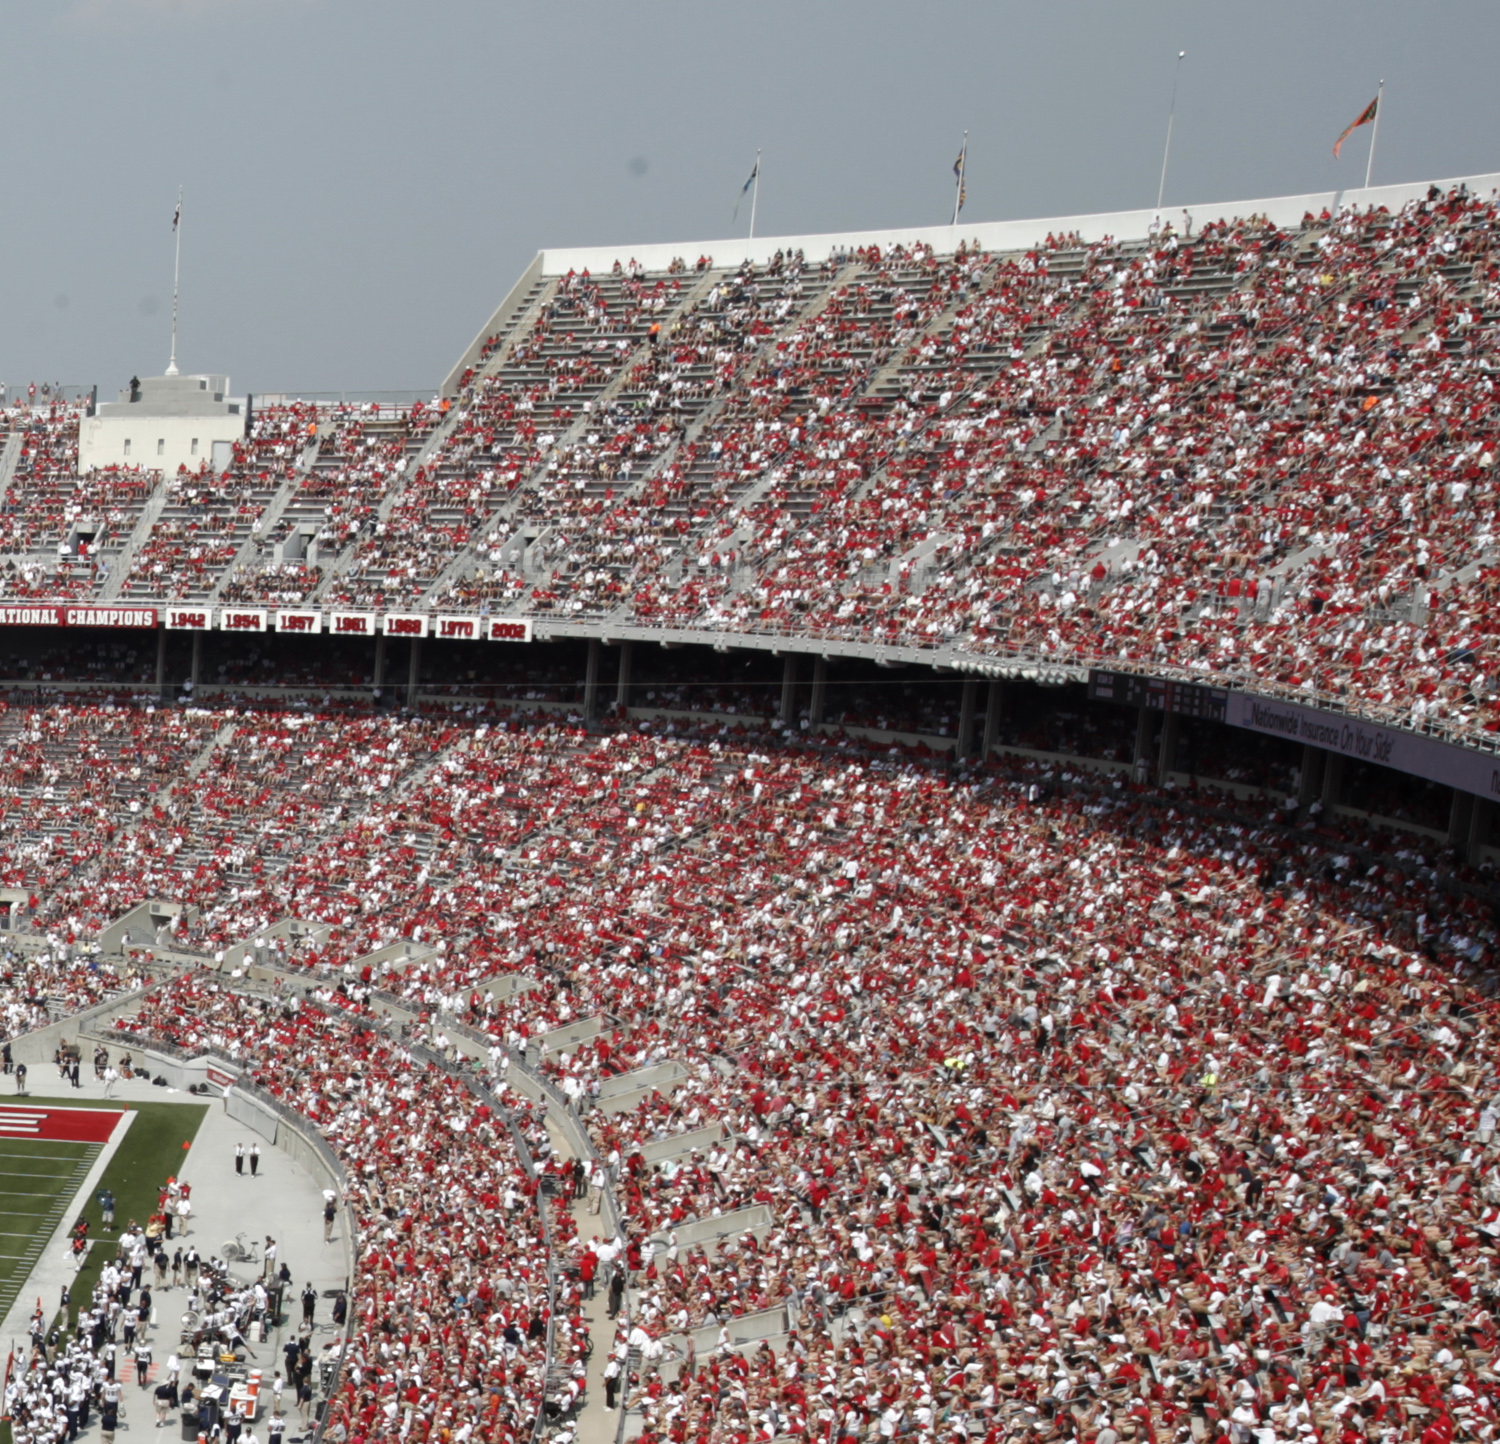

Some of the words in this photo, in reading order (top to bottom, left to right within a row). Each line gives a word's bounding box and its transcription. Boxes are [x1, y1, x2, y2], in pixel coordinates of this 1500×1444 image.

[66, 610, 153, 626] CHAMPIONS
[170, 612, 206, 627] 1942
[225, 614, 260, 629] 1954
[280, 615, 315, 630] 1957
[335, 616, 367, 632] 1961
[387, 618, 421, 634] 1968
[441, 620, 474, 636] 1970
[491, 622, 527, 638] 2002
[1300, 715, 1339, 747] Insurance
[1340, 723, 1355, 750] On
[1355, 728, 1373, 756] Your
